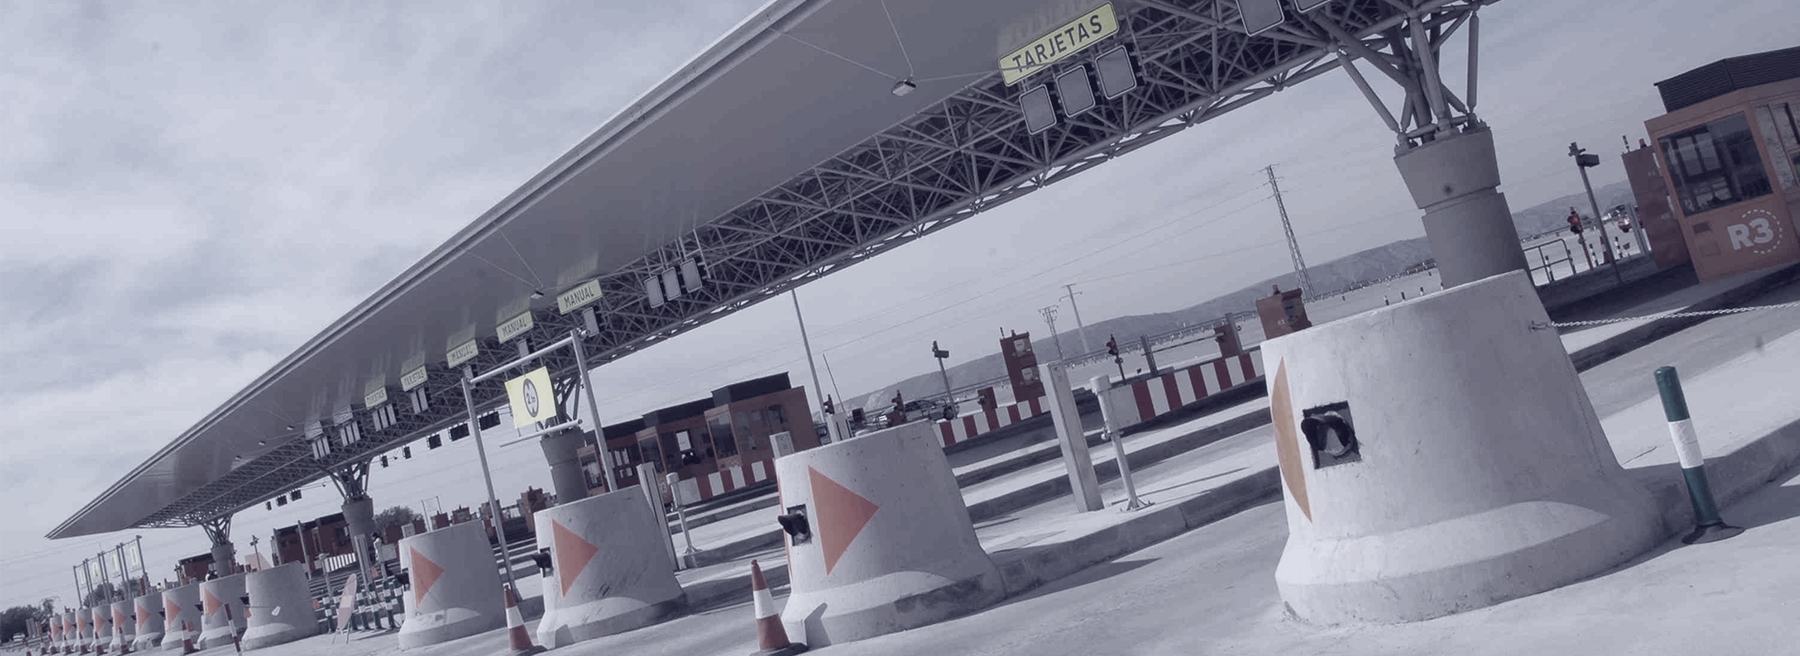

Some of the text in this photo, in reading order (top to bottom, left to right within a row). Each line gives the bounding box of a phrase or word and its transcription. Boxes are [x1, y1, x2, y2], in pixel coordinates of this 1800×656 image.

[1012, 14, 1103, 73] TARJETAS
[1727, 217, 1774, 251] R3
[563, 285, 594, 309] MANUAL
[502, 317, 527, 337] MANUAL
